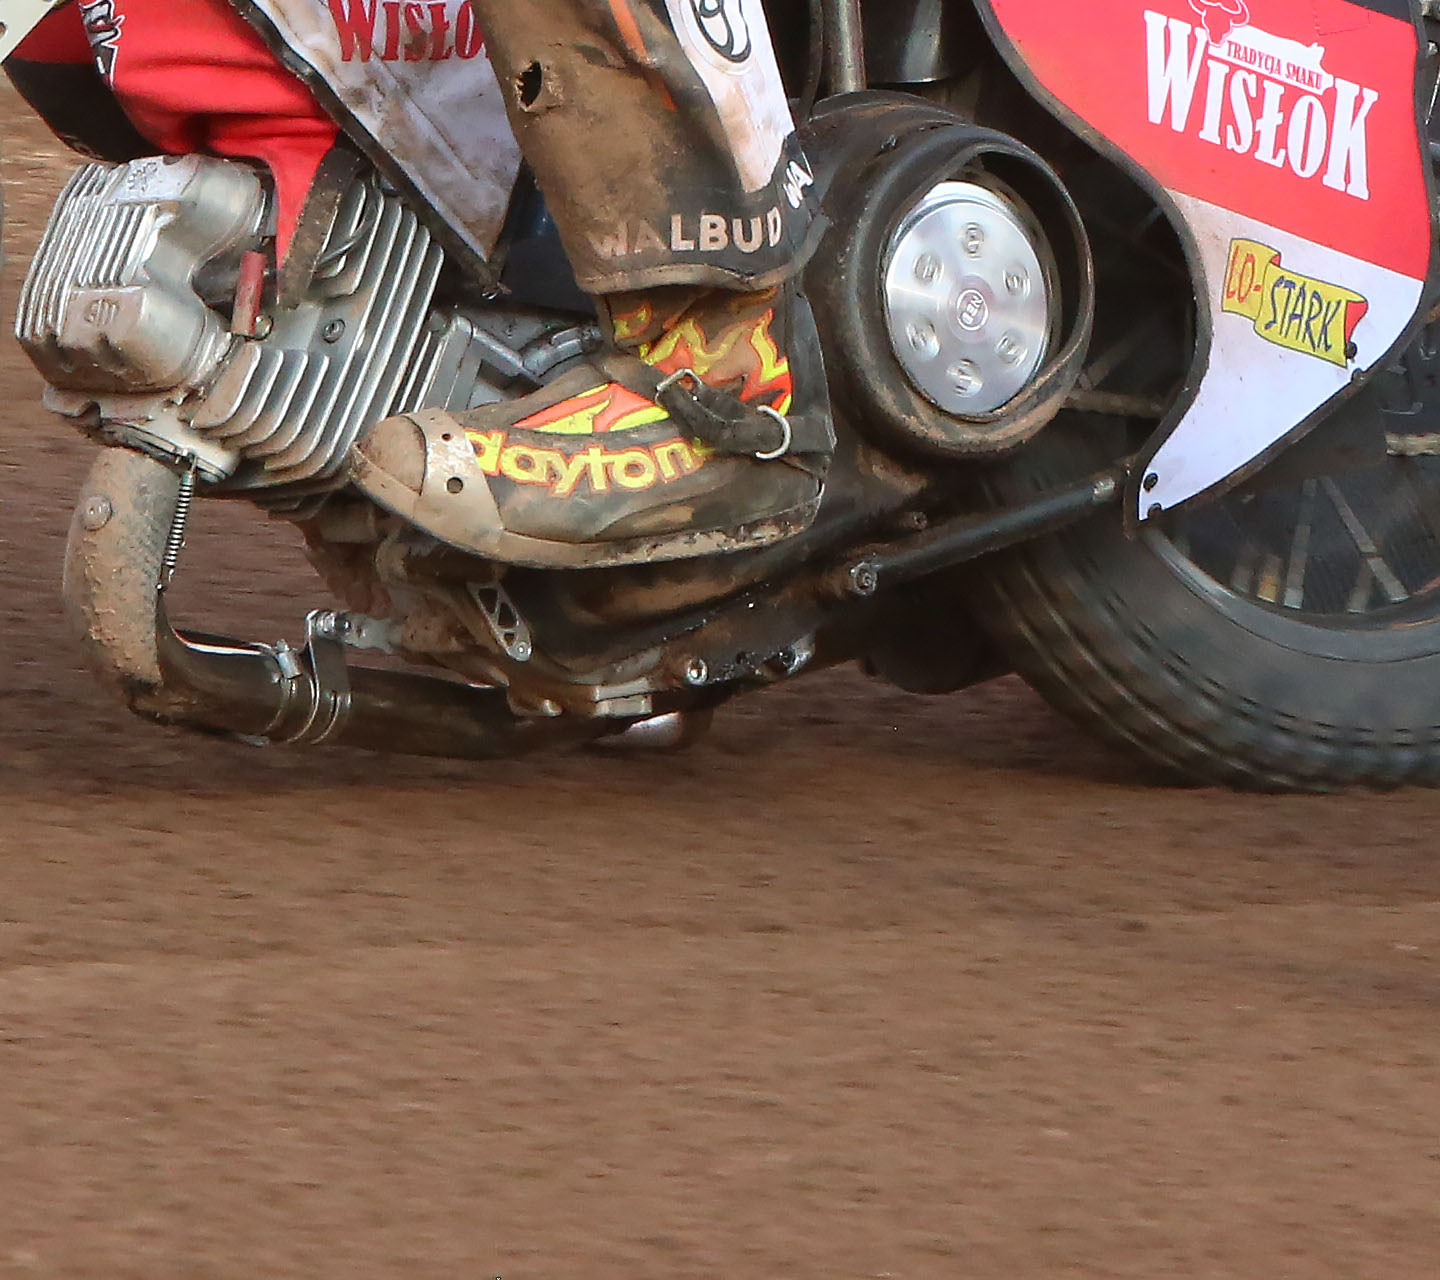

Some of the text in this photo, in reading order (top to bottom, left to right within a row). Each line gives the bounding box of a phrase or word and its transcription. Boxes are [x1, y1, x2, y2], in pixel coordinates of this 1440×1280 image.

[1226, 40, 1323, 90] TRADYCJA SMAKU
[1143, 9, 1380, 201] WISŁOK
[1267, 276, 1340, 352] STARK
